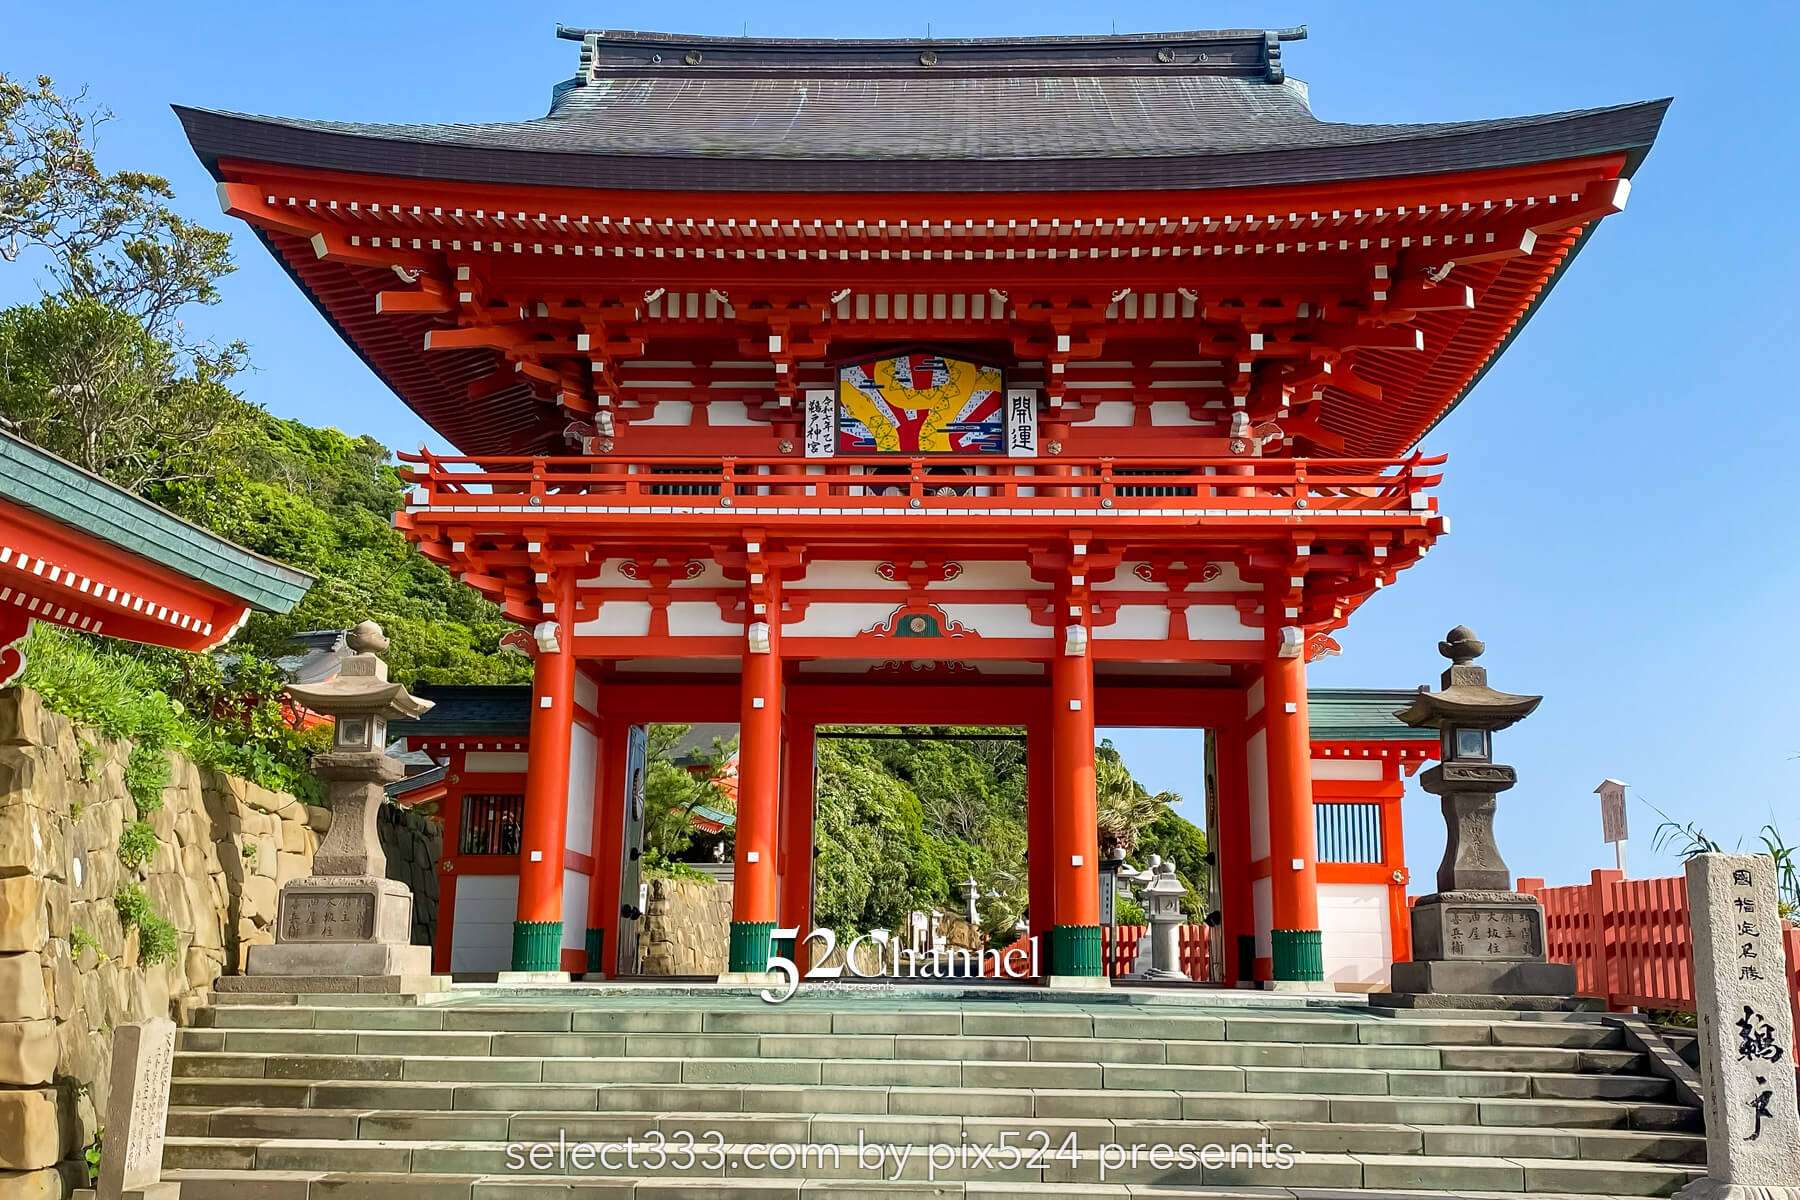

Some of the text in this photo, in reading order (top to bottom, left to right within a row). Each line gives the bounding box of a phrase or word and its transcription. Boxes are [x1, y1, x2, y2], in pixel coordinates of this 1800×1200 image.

[807, 400, 822, 453] 鵜戸神宮
[821, 396, 834, 453] 令和七年乙巳
[1011, 396, 1035, 451] 開運
[1736, 1005, 1784, 1142] 鵜戸
